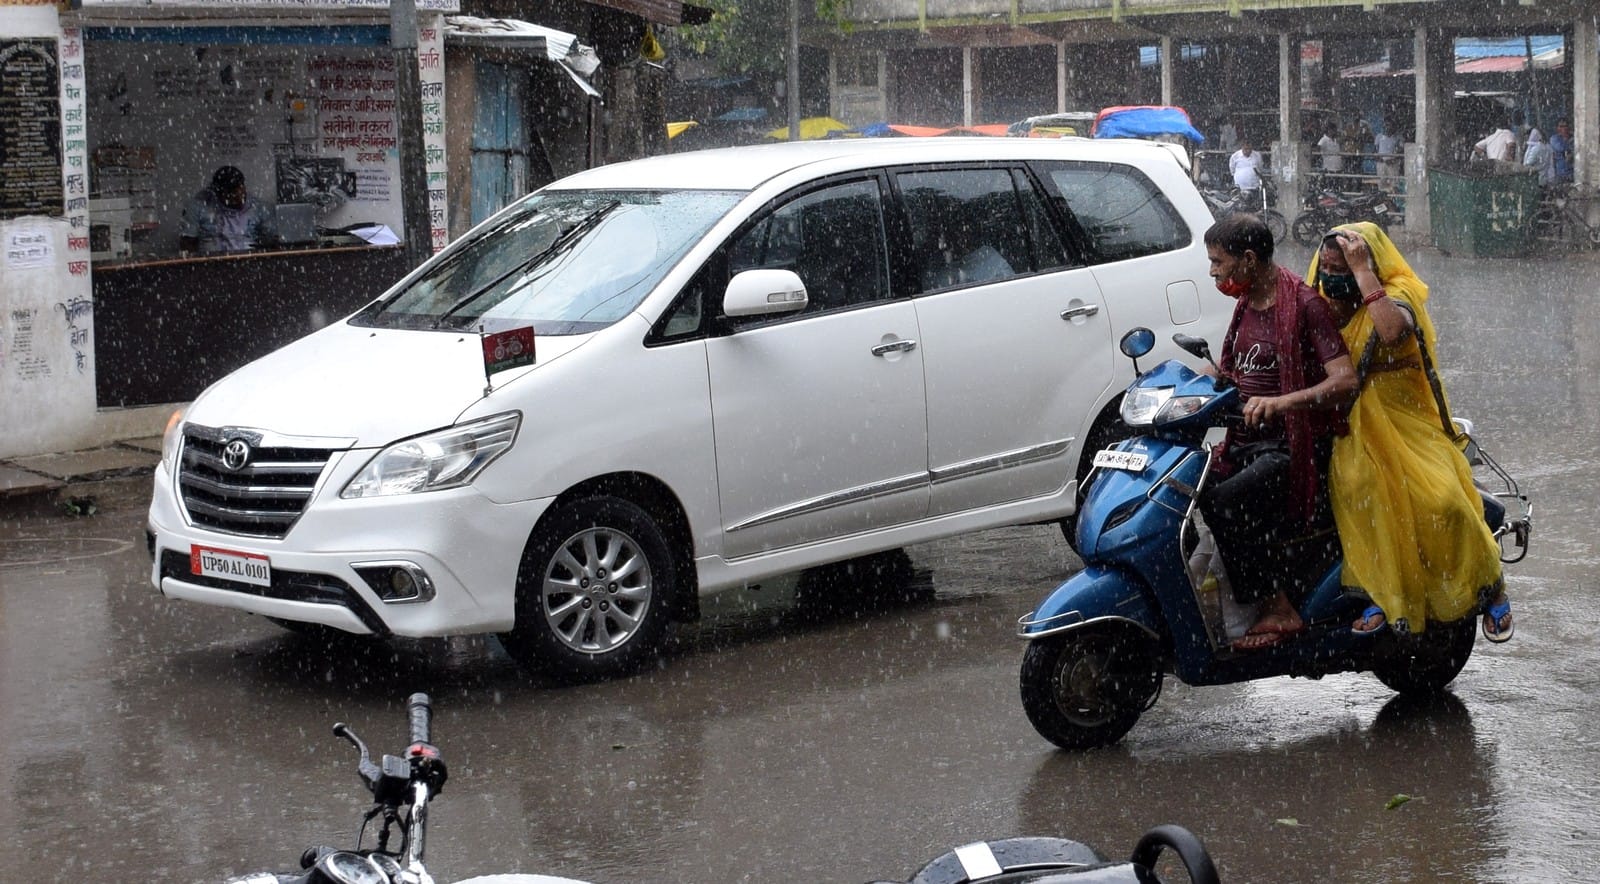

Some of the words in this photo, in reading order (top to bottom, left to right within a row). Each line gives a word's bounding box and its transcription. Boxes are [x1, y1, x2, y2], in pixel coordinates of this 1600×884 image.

[419, 48, 439, 70] जाति
[421, 80, 443, 98] निवास
[71, 325, 88, 350] होता
[75, 351, 86, 374] है
[203, 556, 229, 573] UP50
[231, 561, 244, 575] AL
[245, 563, 268, 579] 0101
